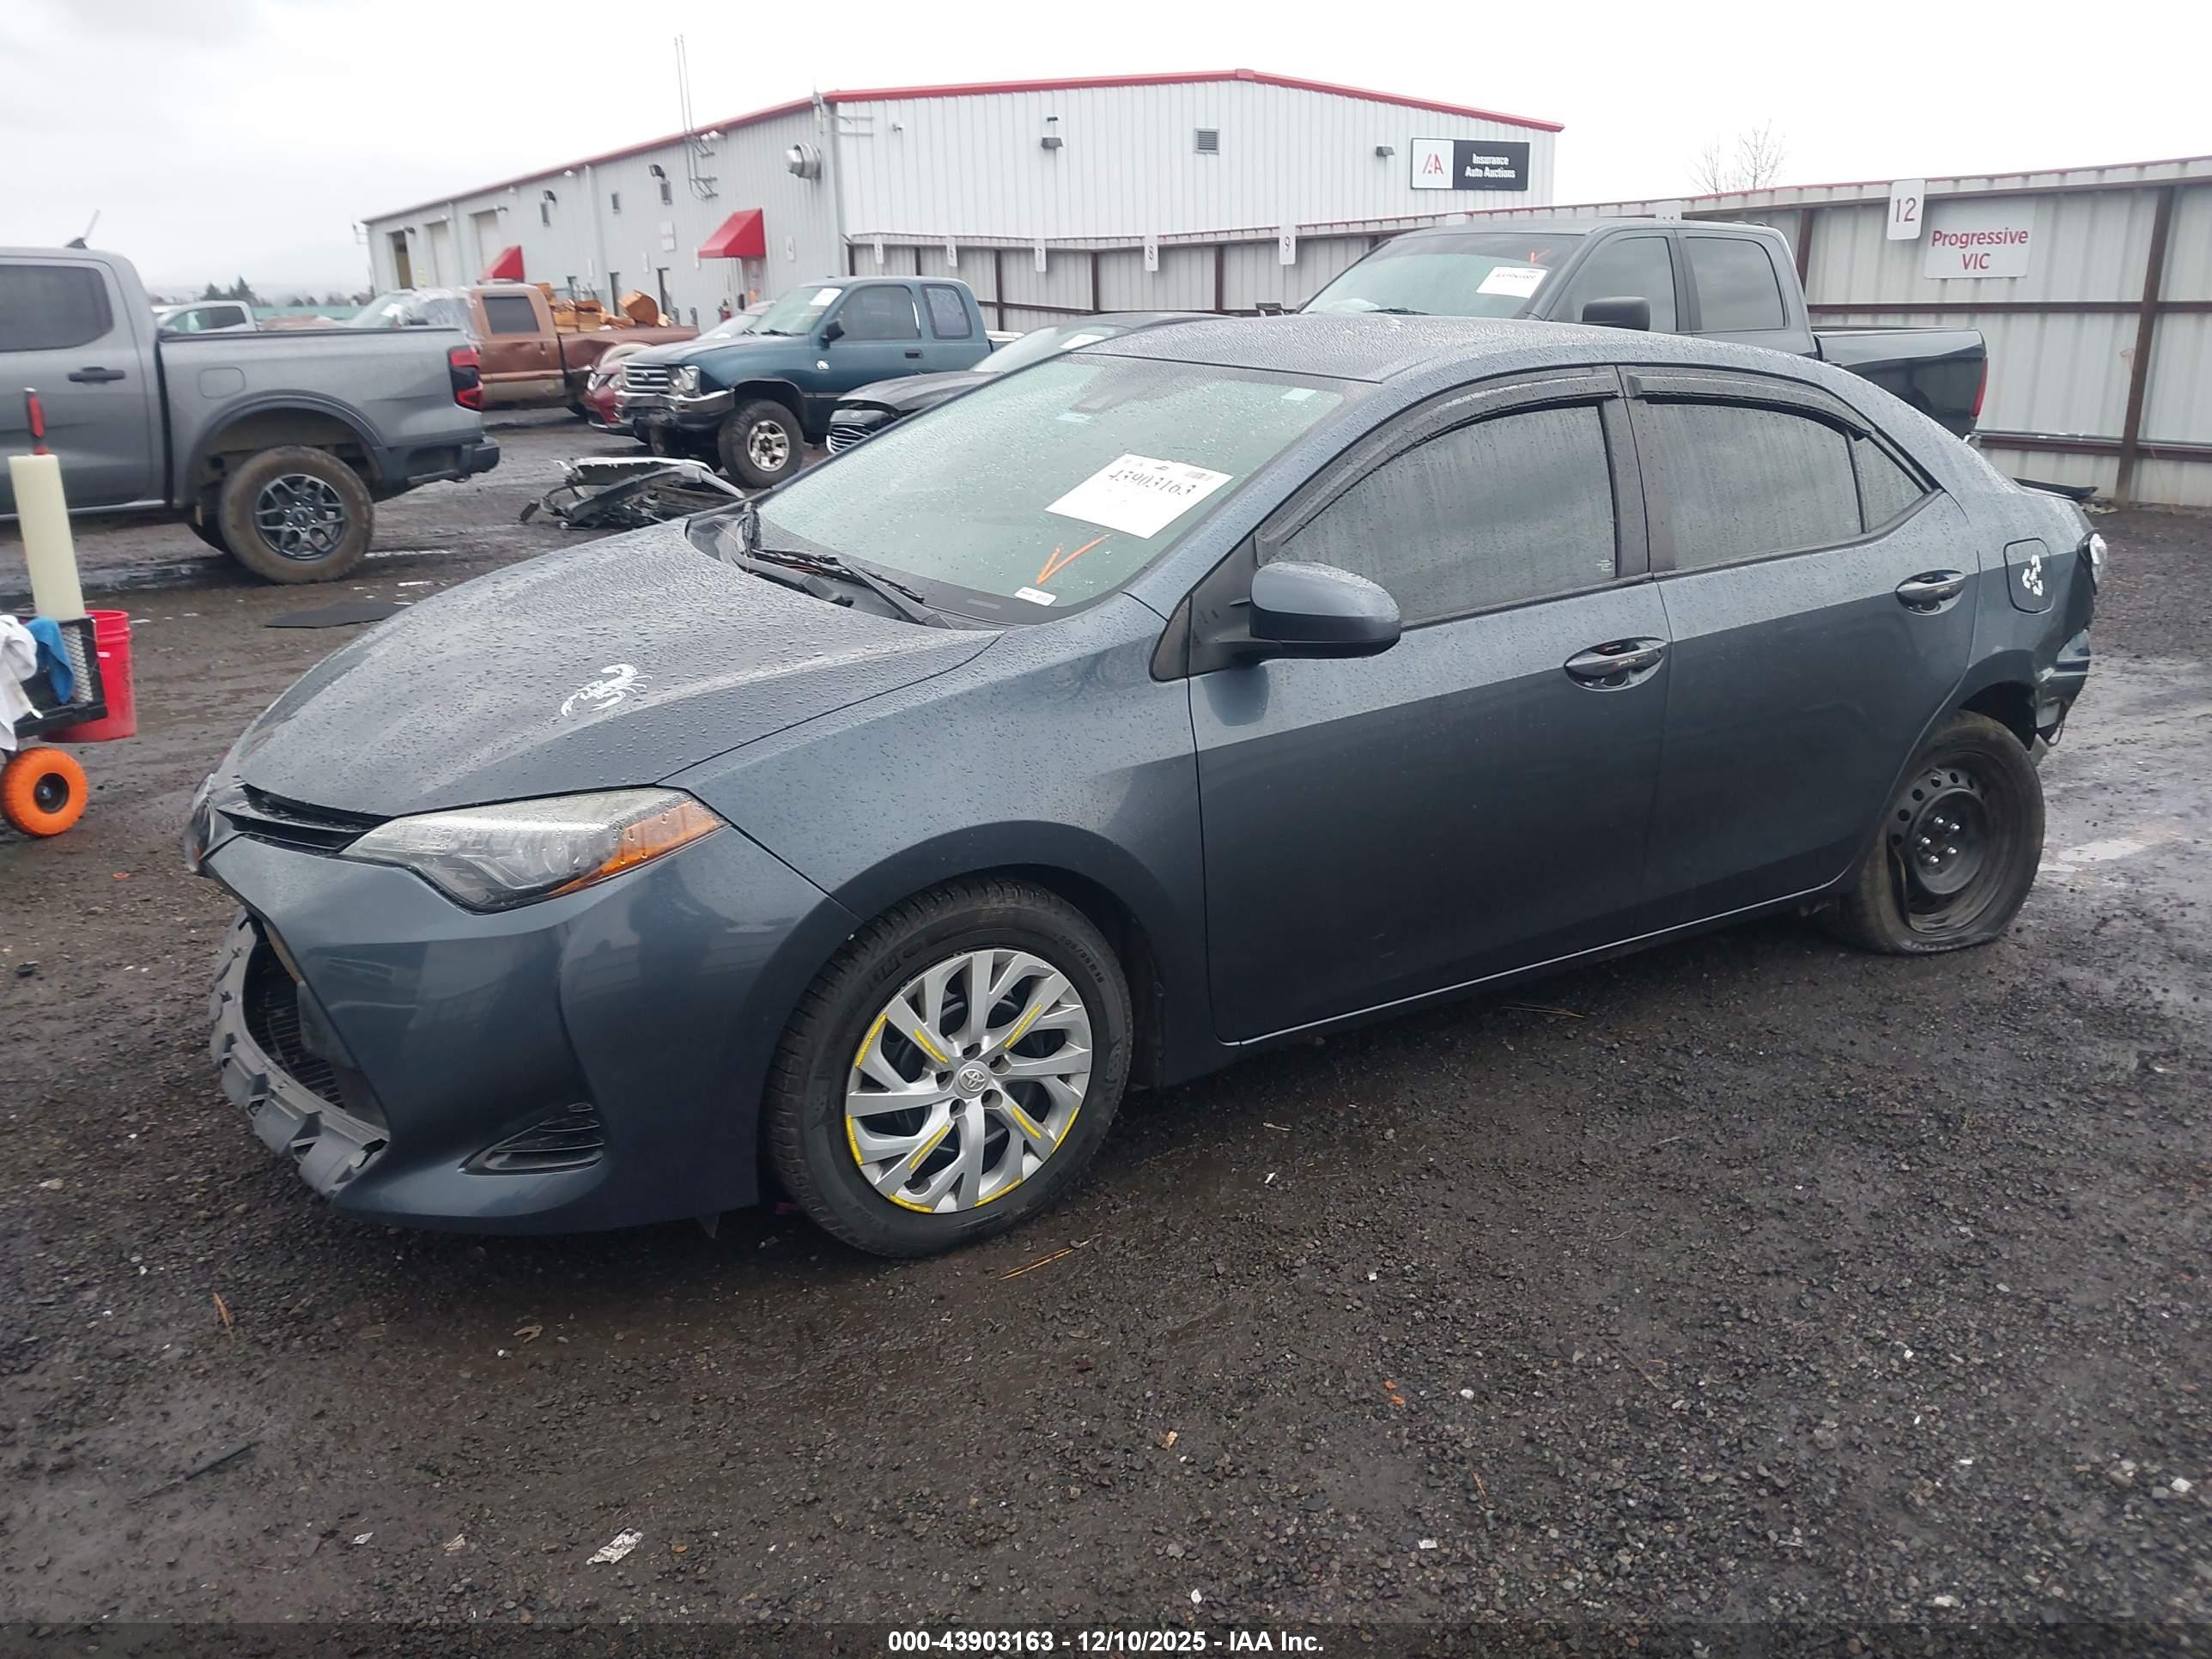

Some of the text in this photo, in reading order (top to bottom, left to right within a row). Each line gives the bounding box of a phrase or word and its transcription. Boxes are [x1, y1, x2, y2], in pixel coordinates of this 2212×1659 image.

[1472, 153, 1510, 165] Insurance
[1465, 166, 1516, 179] Auto Auctions
[1895, 197, 1917, 222] 12
[1932, 227, 2028, 249] Progressive
[1962, 252, 1991, 270] VIC
